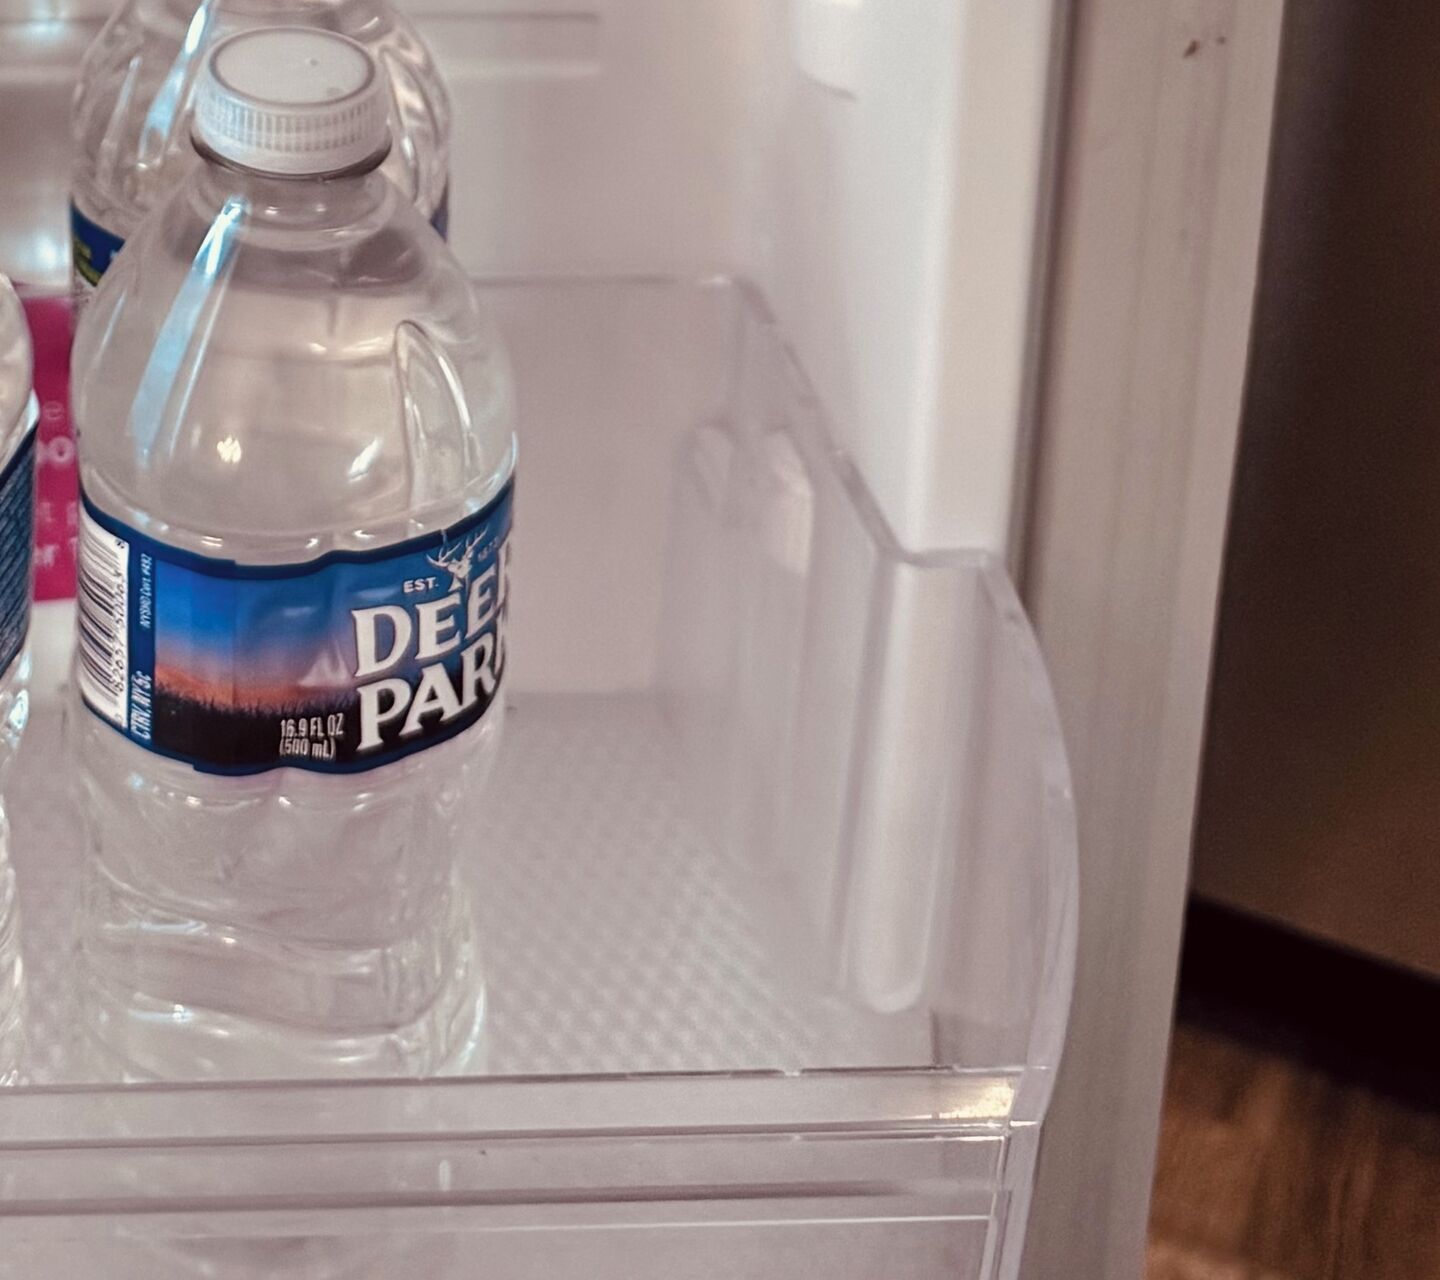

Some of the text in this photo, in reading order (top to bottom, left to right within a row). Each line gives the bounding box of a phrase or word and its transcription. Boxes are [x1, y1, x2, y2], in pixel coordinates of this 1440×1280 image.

[403, 576, 439, 593] EST.
[350, 538, 508, 678] DEE
[355, 614, 503, 752] PAR
[280, 712, 345, 738] 16.9 FL OZ
[279, 737, 337, 760] (500 mL)
